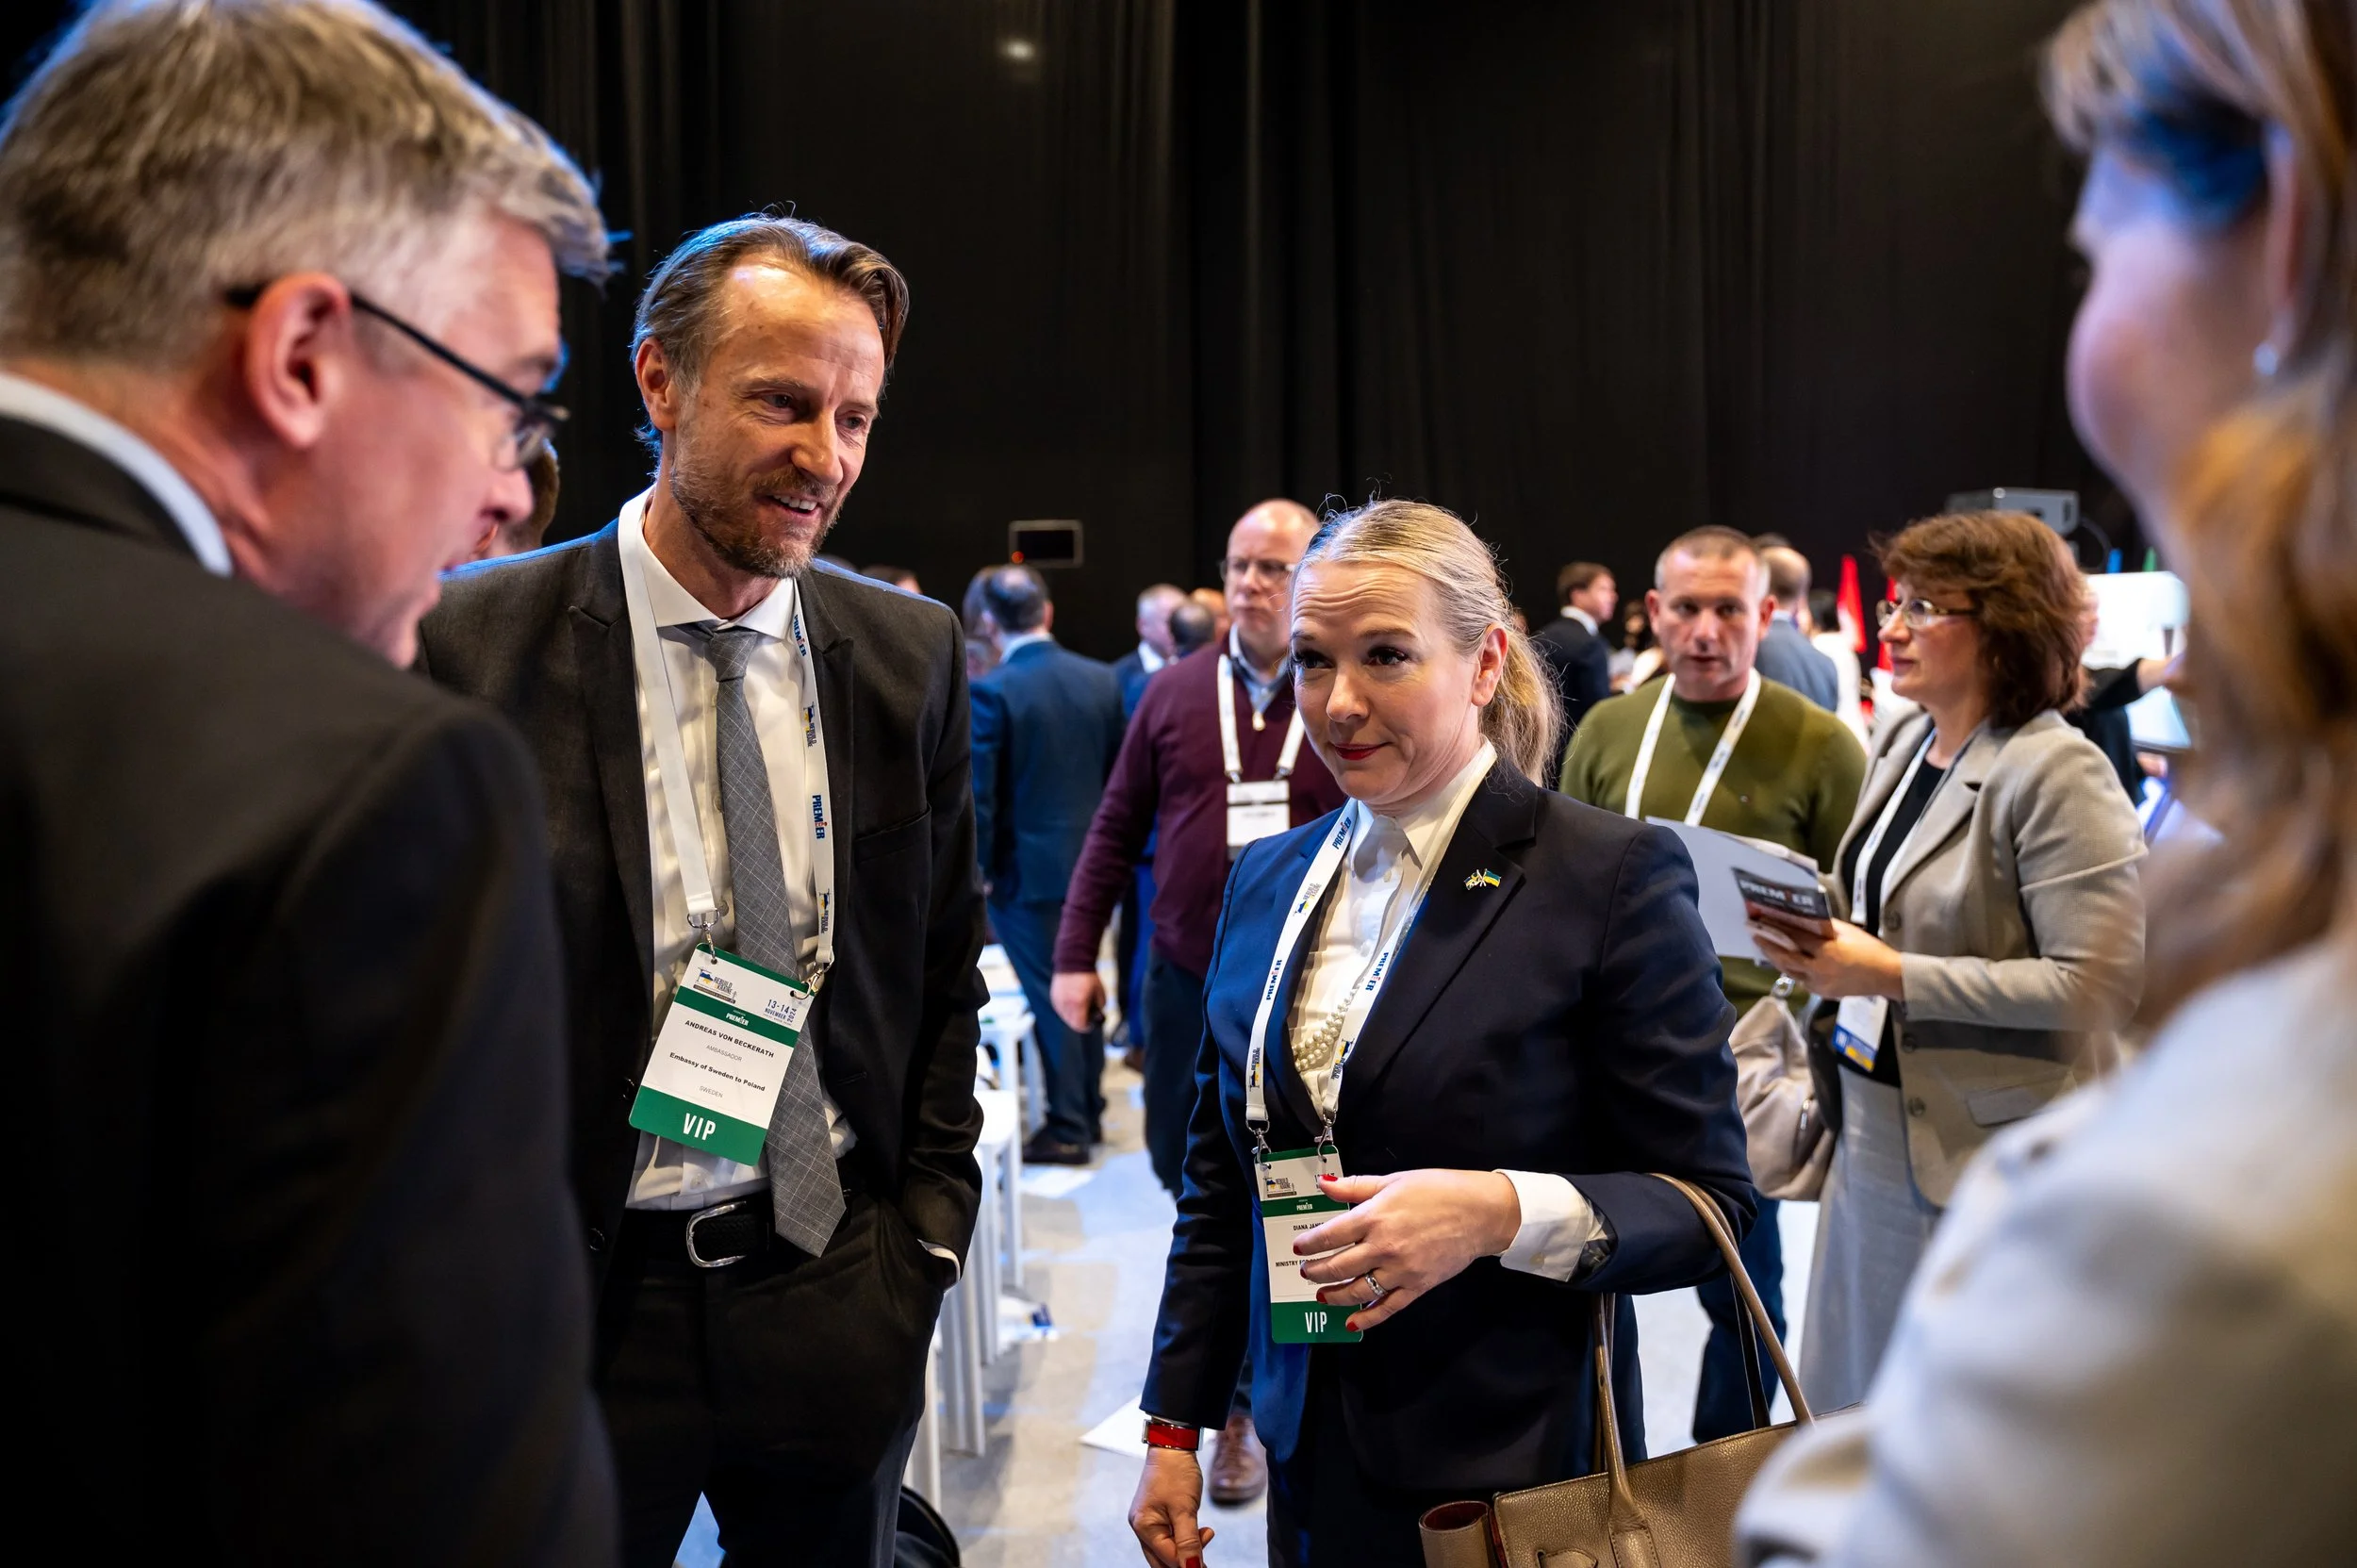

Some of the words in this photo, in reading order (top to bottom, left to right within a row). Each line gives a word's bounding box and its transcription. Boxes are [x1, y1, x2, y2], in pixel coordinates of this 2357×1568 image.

[812, 794, 828, 839] PREMIER
[1364, 951, 1390, 991] PREMIER
[765, 1008, 786, 1020] NOVEMBER
[786, 1008, 798, 1023] 2024
[684, 1020, 717, 1036] ANDREAS
[718, 1032, 733, 1043] VON
[733, 1038, 775, 1058] BECKERATH
[705, 1045, 743, 1062] AMBASSADOR
[669, 1051, 700, 1067] Embassy
[708, 1065, 733, 1080] Sweden
[743, 1079, 766, 1092] Poland
[699, 1085, 723, 1098] SWEDEN
[682, 1112, 717, 1141] VIP
[1305, 1312, 1327, 1333] VIP
